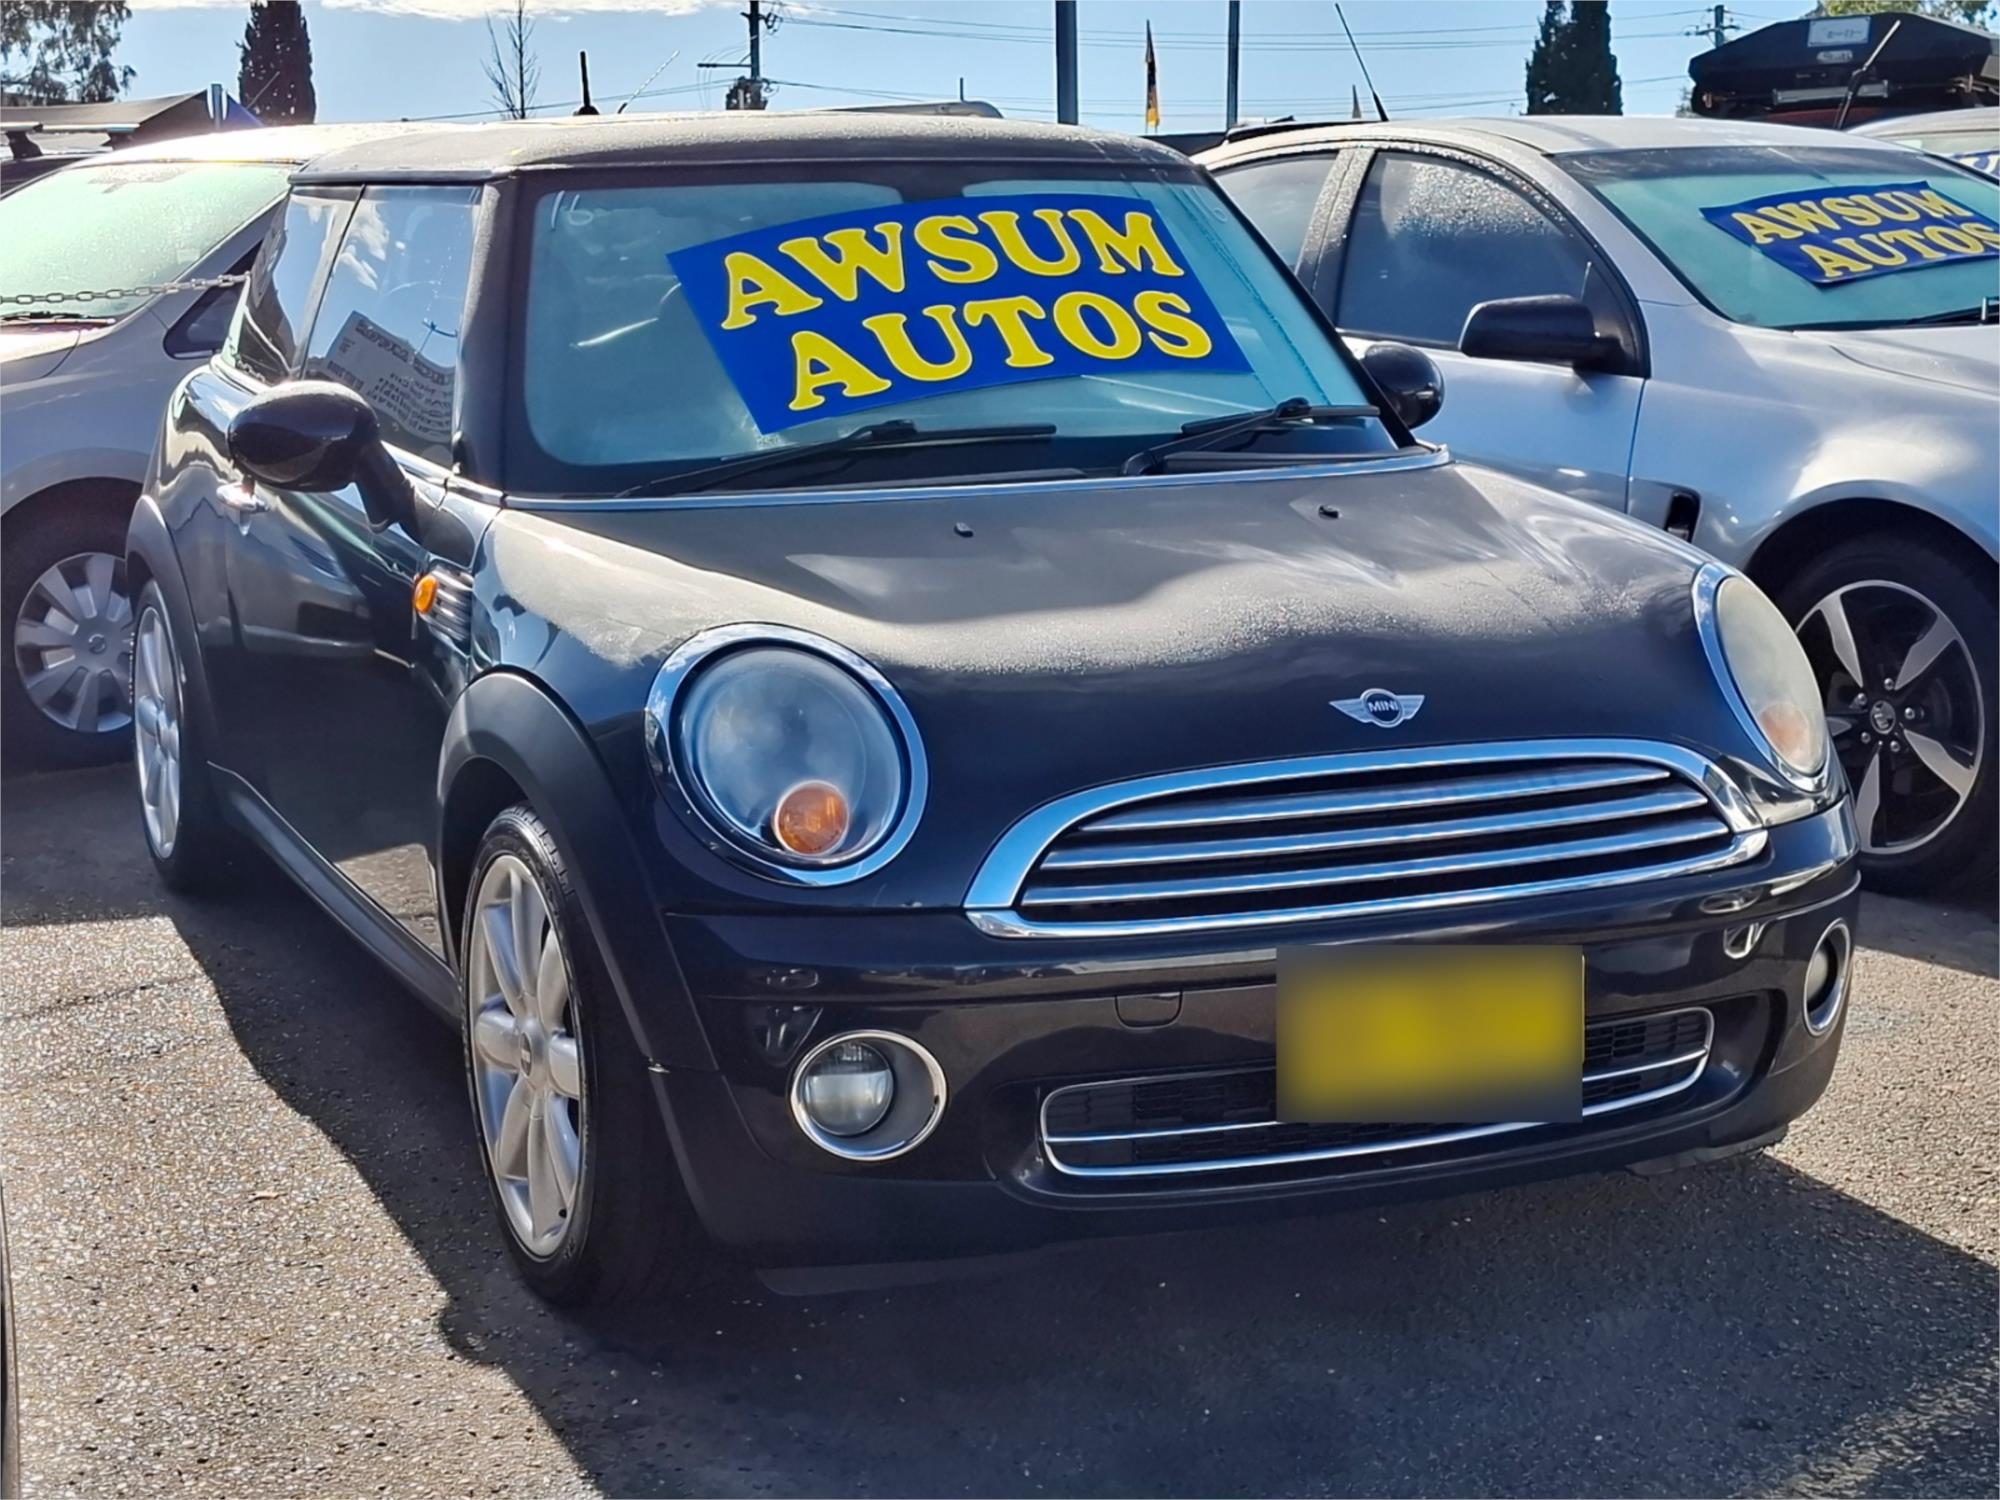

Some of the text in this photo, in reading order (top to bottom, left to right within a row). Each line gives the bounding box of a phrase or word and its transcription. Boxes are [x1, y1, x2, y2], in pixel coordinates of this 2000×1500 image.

[1732, 190, 1974, 244] AWSUM
[722, 208, 1184, 330] AWSUM
[1800, 223, 2000, 277] AUTOS
[788, 291, 1212, 411] AUTOS
[1367, 700, 1399, 713] MINI
